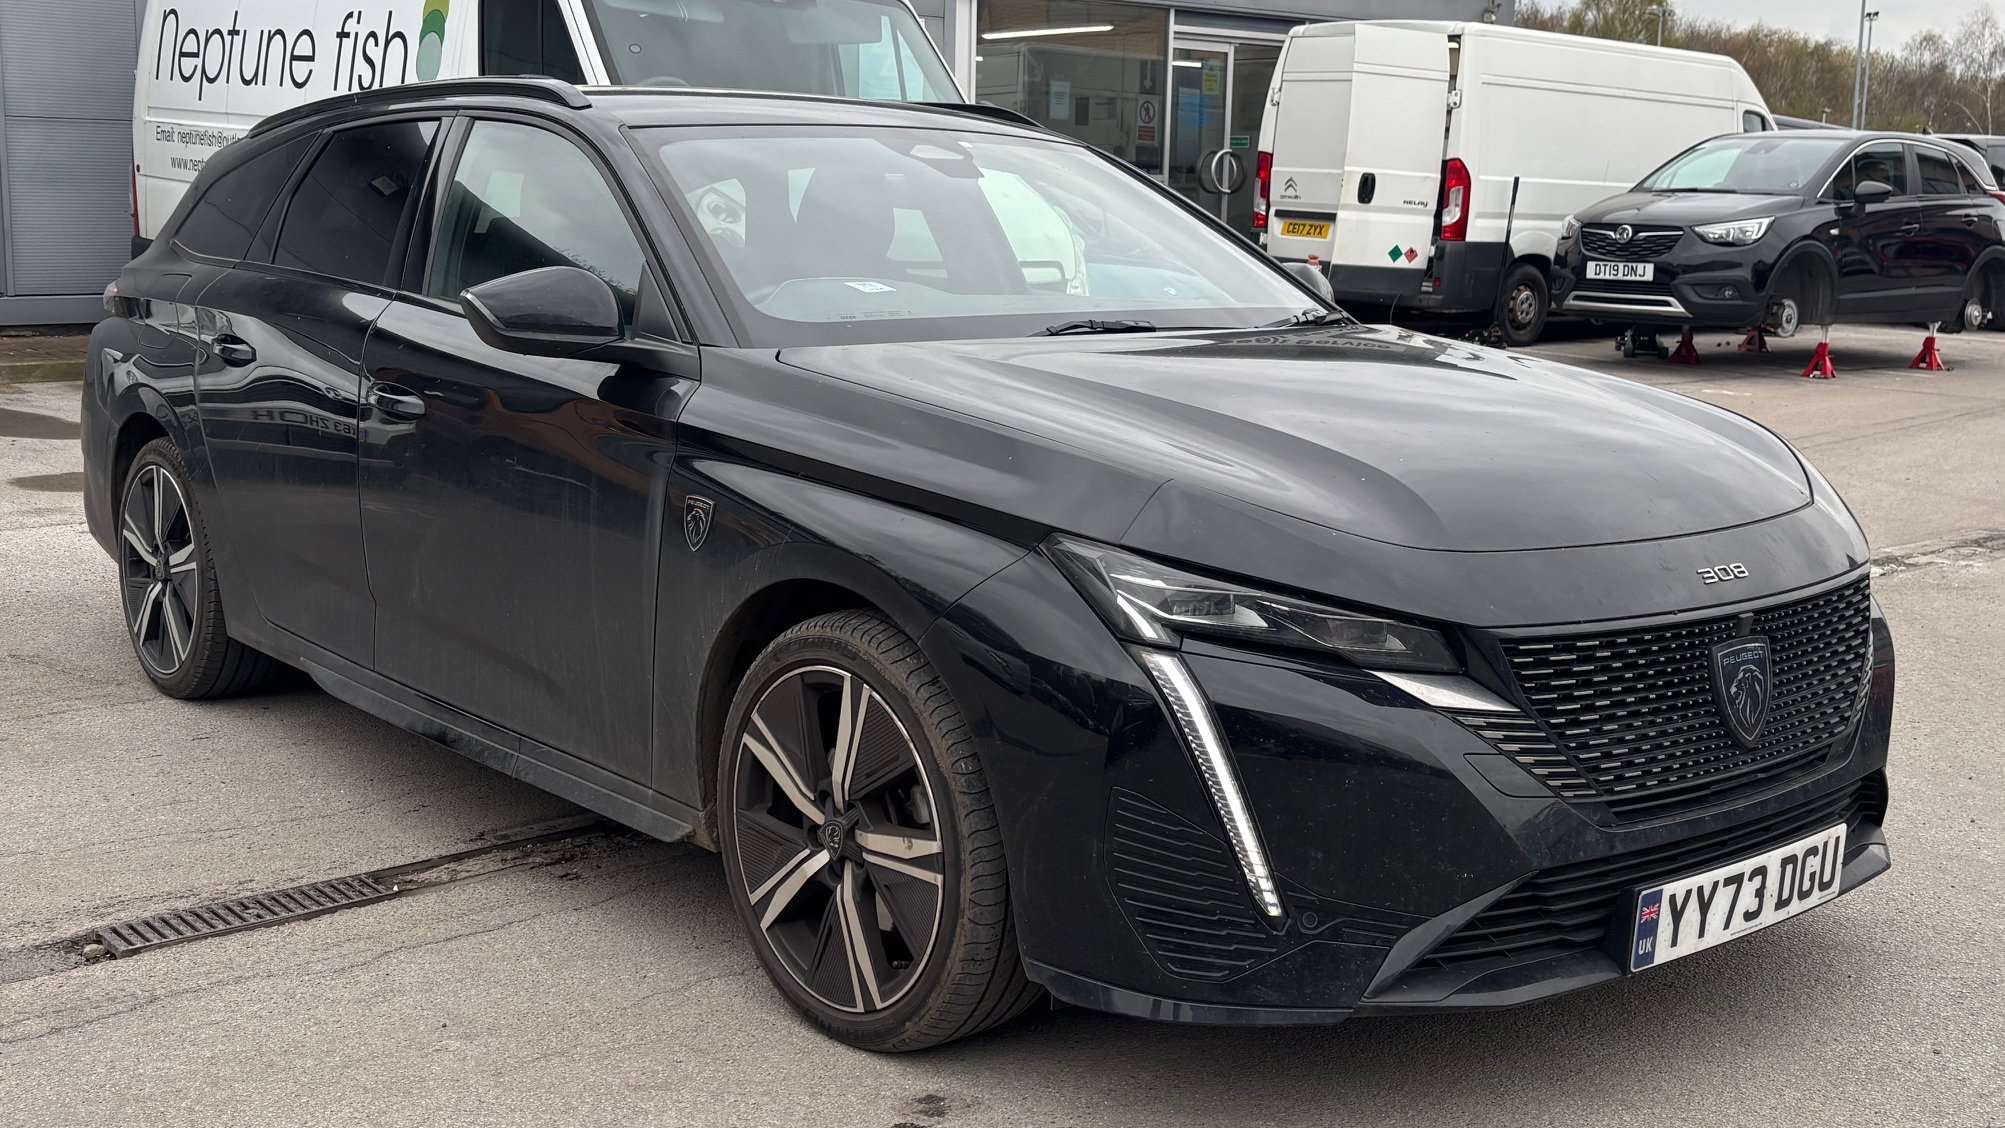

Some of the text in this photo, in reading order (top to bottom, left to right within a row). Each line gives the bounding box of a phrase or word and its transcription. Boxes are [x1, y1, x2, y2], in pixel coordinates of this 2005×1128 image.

[333, 10, 409, 92] fish
[177, 128, 241, 148] neptunefish@outl
[170, 156, 207, 172] www.nept
[1306, 223, 1325, 236] ZYX
[1594, 263, 1647, 278] DT19 DNJ
[1696, 562, 1749, 585] 308
[1723, 650, 1764, 667] PEUGEOT
[1668, 835, 1840, 949] YY73 DGU
[1638, 936, 1654, 955] UK
